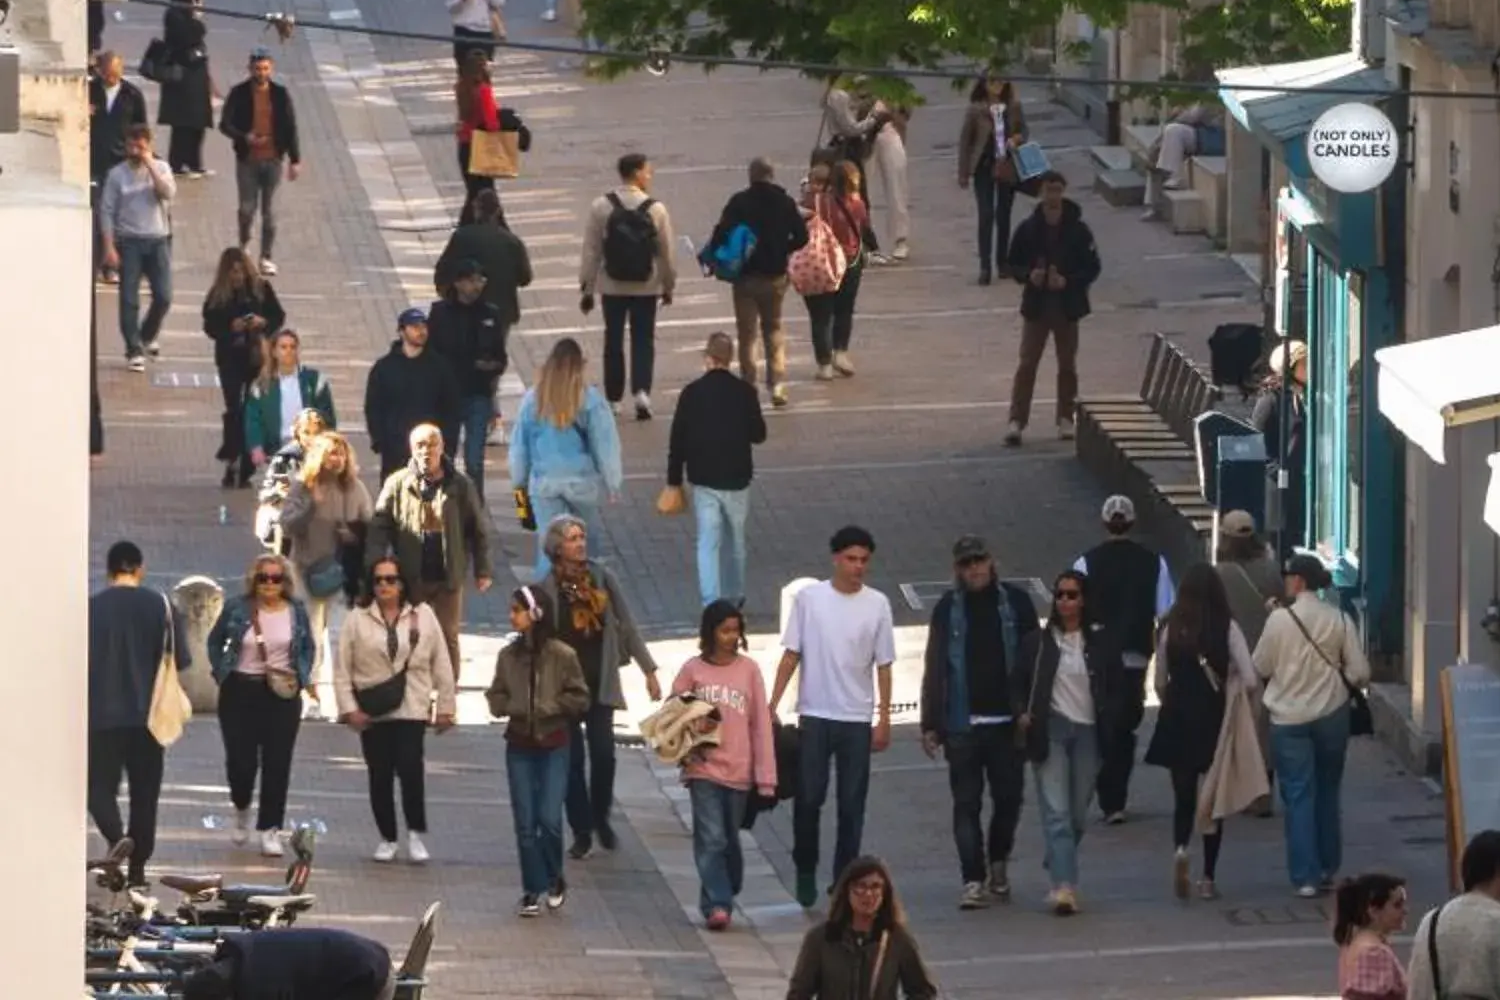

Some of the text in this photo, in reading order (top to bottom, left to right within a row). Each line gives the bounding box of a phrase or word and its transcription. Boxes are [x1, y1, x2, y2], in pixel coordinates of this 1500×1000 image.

[1313, 128, 1391, 142] (NOT ONLY)
[1314, 143, 1391, 158] CANDLES
[693, 683, 746, 715] HICAGO
